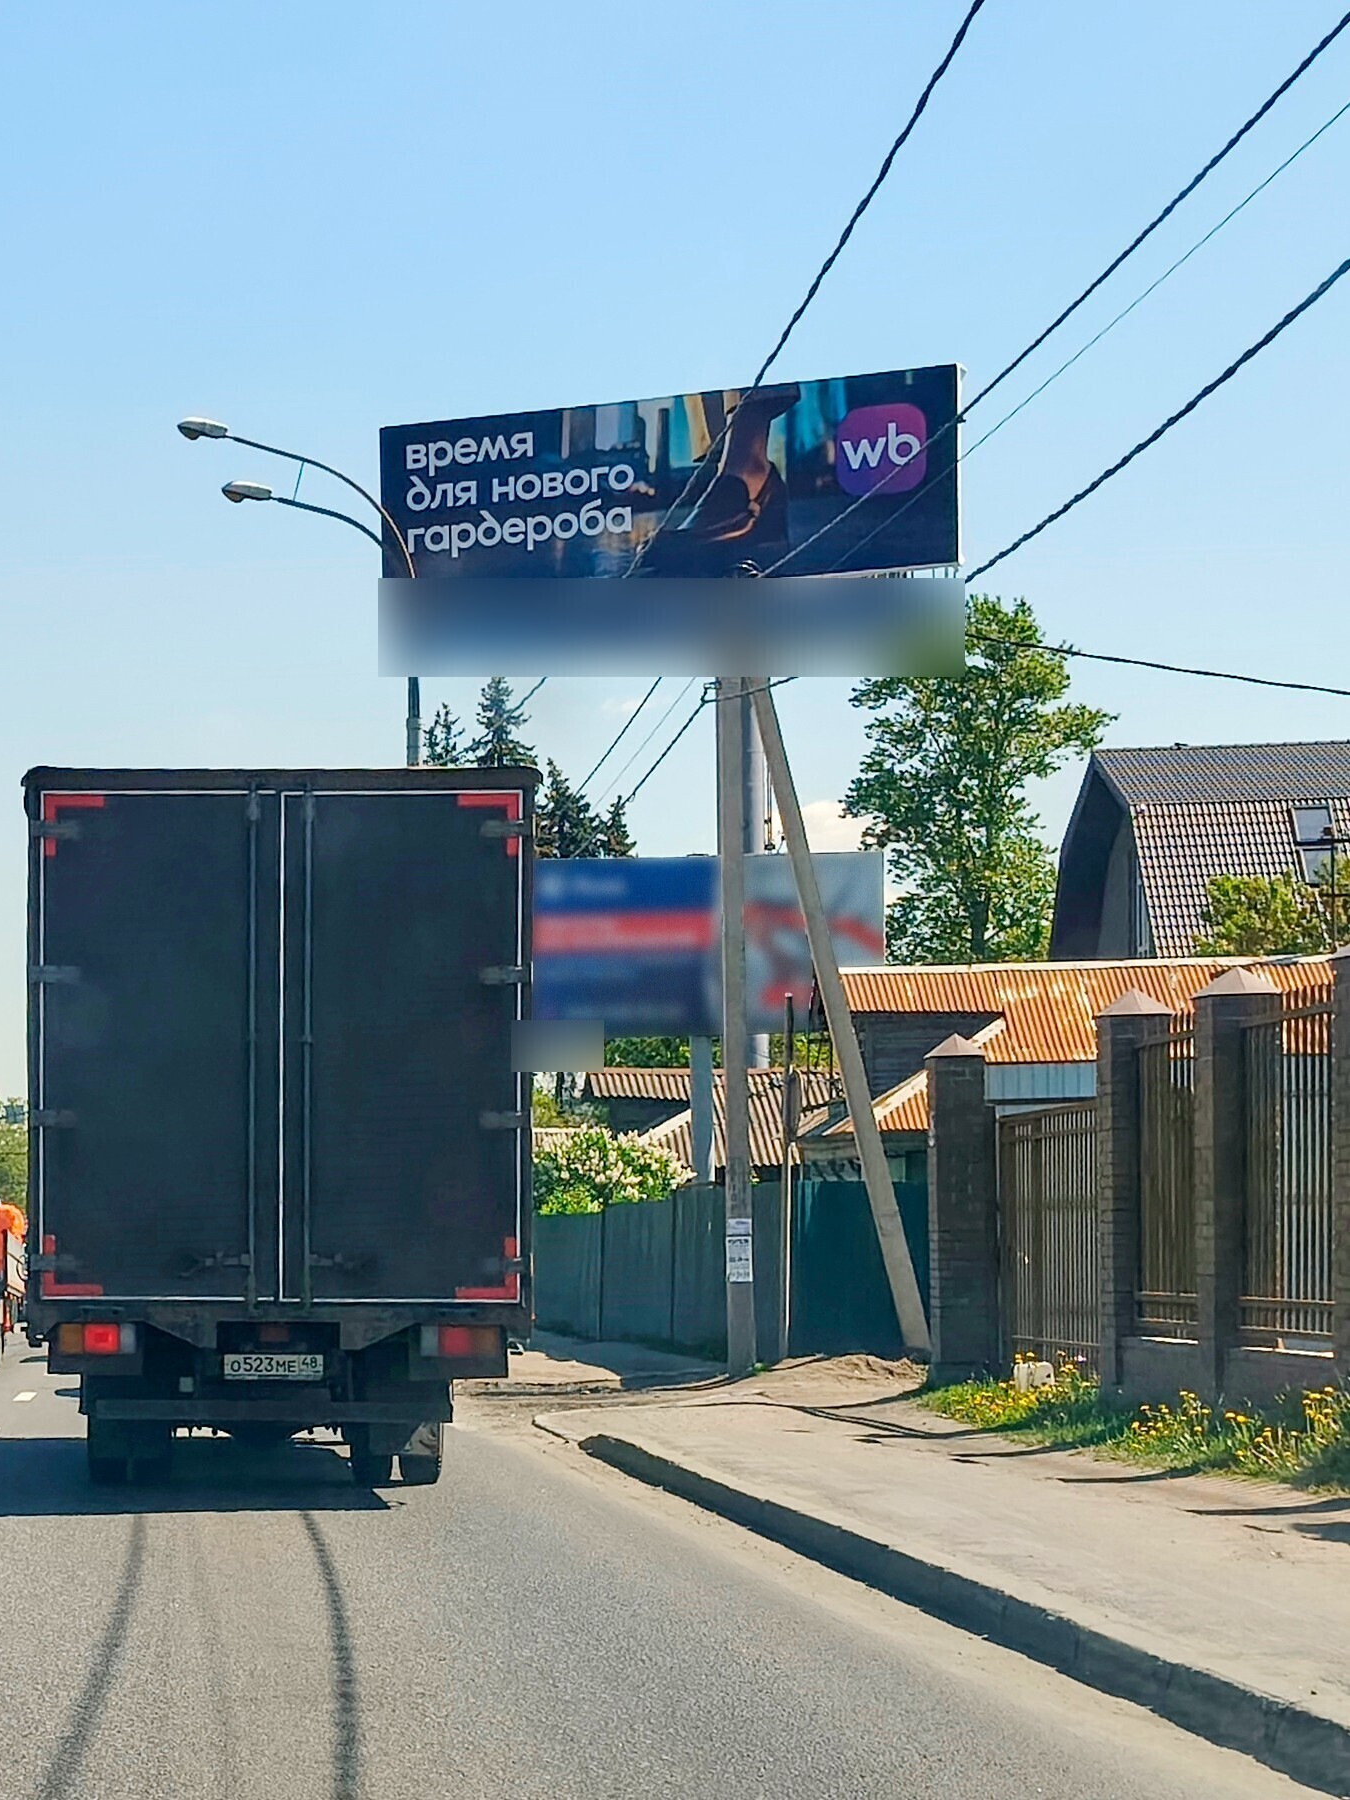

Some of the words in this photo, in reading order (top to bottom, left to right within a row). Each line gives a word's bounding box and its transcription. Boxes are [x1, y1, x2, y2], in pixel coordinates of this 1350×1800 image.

[405, 429, 534, 477] время
[840, 421, 921, 470] wb
[405, 475, 478, 513] для
[491, 460, 635, 503] нового
[406, 499, 633, 558] гардероба
[230, 1356, 297, 1373] О523МЕ
[301, 1356, 318, 1369] 48
